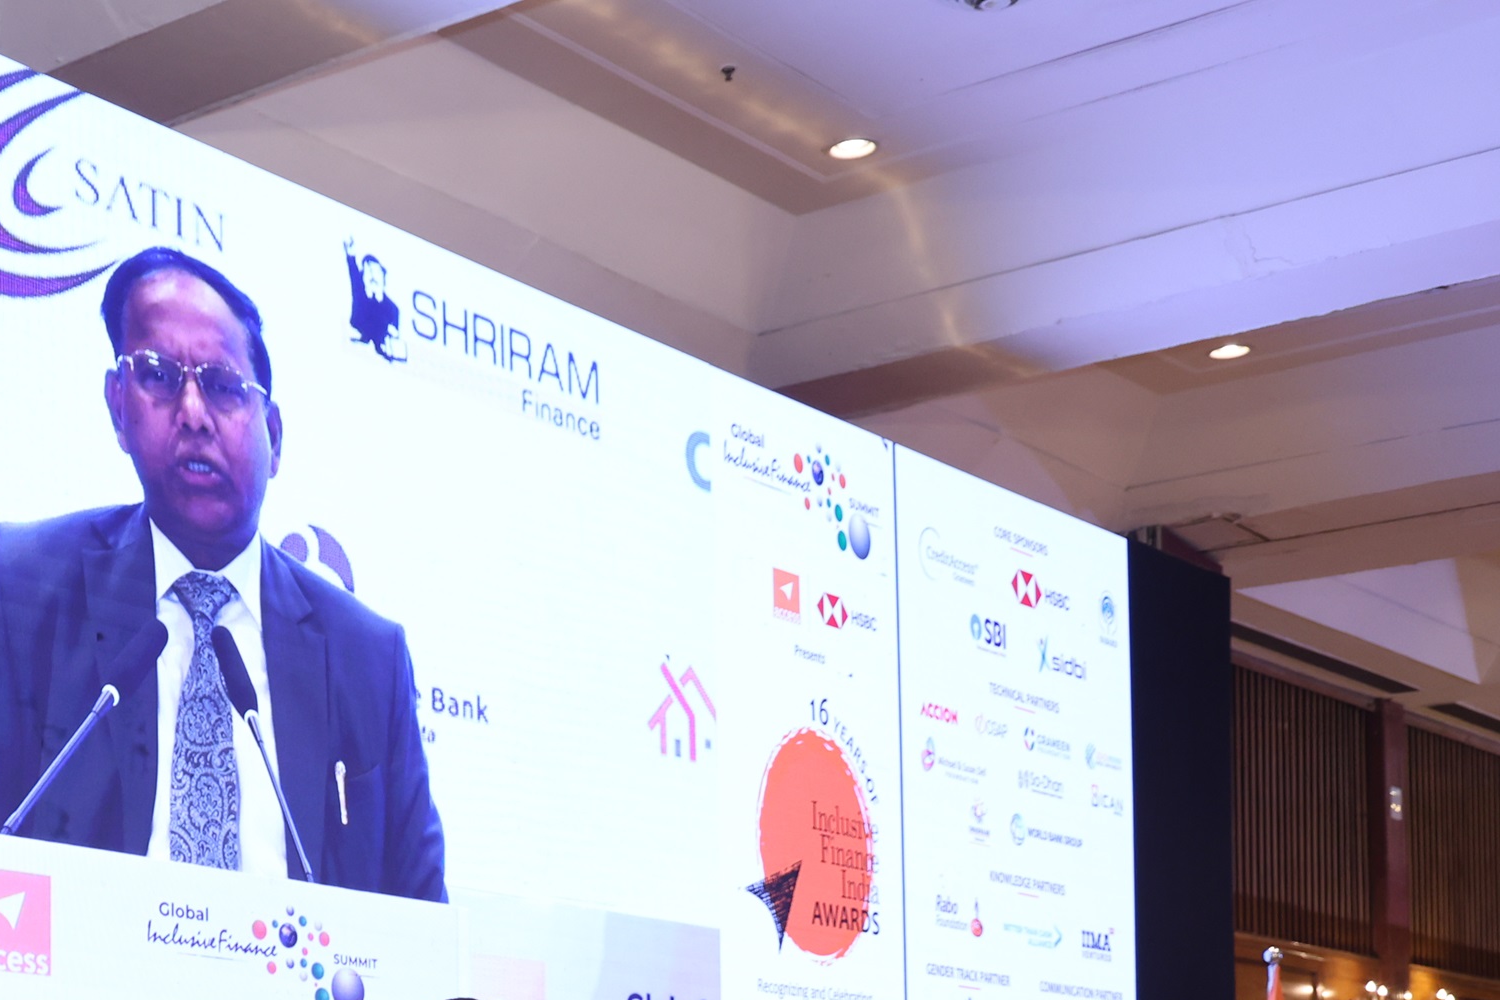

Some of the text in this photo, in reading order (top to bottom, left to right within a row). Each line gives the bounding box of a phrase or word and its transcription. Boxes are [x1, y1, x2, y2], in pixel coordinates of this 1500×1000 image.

[74, 157, 224, 252] SATIN
[411, 290, 599, 404] SHRIRAM
[522, 388, 600, 440] Finance
[730, 423, 765, 448] Global
[984, 618, 1007, 650] SBI
[431, 687, 489, 724] Bank
[810, 698, 829, 725] 16
[833, 716, 868, 774] YEARS
[820, 833, 880, 875] Finance
[841, 869, 880, 904] India
[159, 901, 209, 922] Global
[812, 901, 880, 935] AWARDS
[334, 954, 377, 969] SUMMIT
[811, 985, 826, 1000] and
